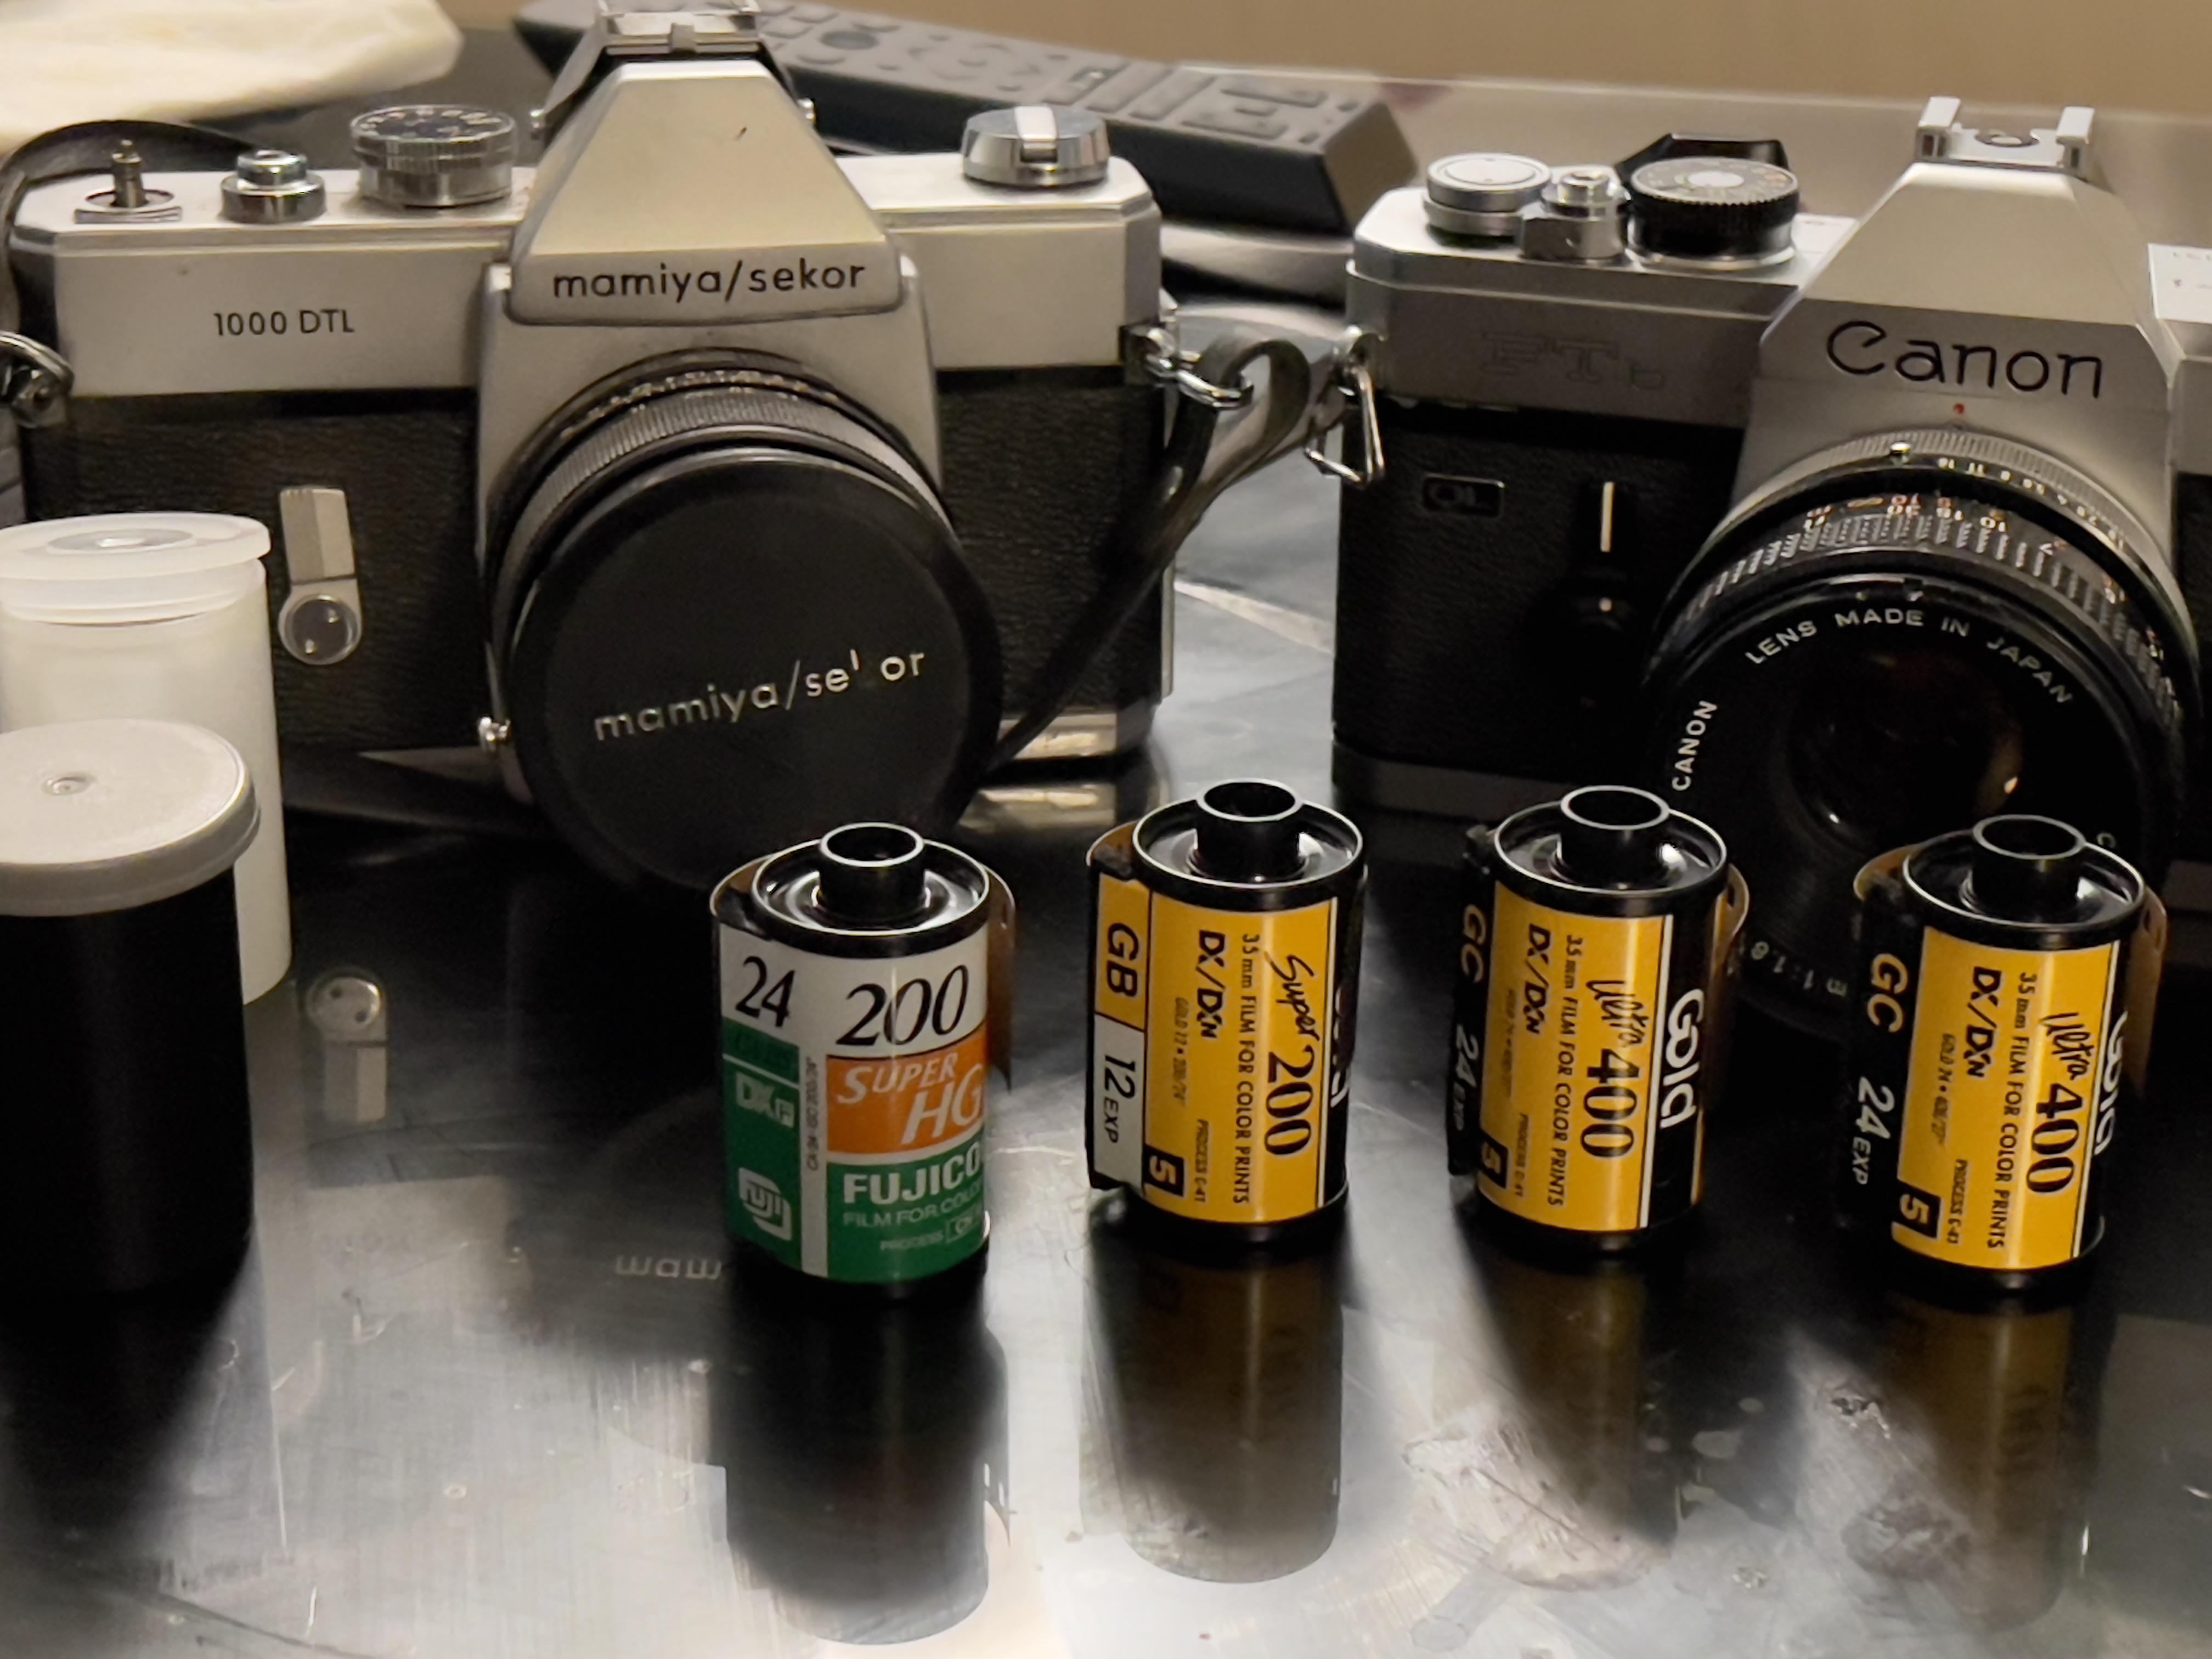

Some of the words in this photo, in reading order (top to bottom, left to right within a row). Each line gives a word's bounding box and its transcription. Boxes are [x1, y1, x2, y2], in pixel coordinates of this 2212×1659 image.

[553, 257, 865, 303] mamiya/sekor
[213, 312, 286, 336] 1000
[300, 309, 354, 334] DTL
[1826, 320, 2103, 399] Canon
[1745, 620, 1818, 664] LENS
[1834, 608, 1925, 628] MADE
[1941, 617, 1970, 637] IN
[1986, 637, 2073, 703] JAPAN
[1672, 700, 1718, 791] CANON
[1105, 922, 1140, 1000] GB
[1460, 904, 1488, 984] GC
[735, 956, 796, 1028] 24
[835, 964, 969, 1046] 200
[1239, 995, 1257, 1034] FILM
[1264, 950, 1321, 1042] Super
[1559, 995, 1579, 1036] FILM
[1866, 952, 1909, 1034] GC
[1238, 1037, 1256, 1076] FOR
[1556, 1040, 1577, 1077] FOR
[2008, 1036, 2031, 1077] FILM
[2038, 1012, 2097, 1081] Ultra
[838, 1052, 959, 1104] SUPER
[901, 1063, 984, 1145] HG
[1264, 1044, 1316, 1156] 200
[1580, 1048, 1641, 1159] 400
[2004, 1080, 2025, 1118] FOR
[1234, 1080, 1255, 1141] COLOR
[1551, 1082, 1572, 1144] COLOR
[2026, 1082, 2085, 1194] 400
[1149, 1155, 1178, 1186] 5
[1233, 1144, 1253, 1206] PRINTS
[1547, 1147, 1568, 1207] PRINTS
[1995, 1121, 2020, 1186] COLOR
[843, 1210, 891, 1228] FILM
[896, 1204, 938, 1225] FOR
[1899, 1192, 1929, 1224] 5
[1950, 1159, 1968, 1216] PROCESS
[1987, 1188, 2014, 1250] PRINTS
